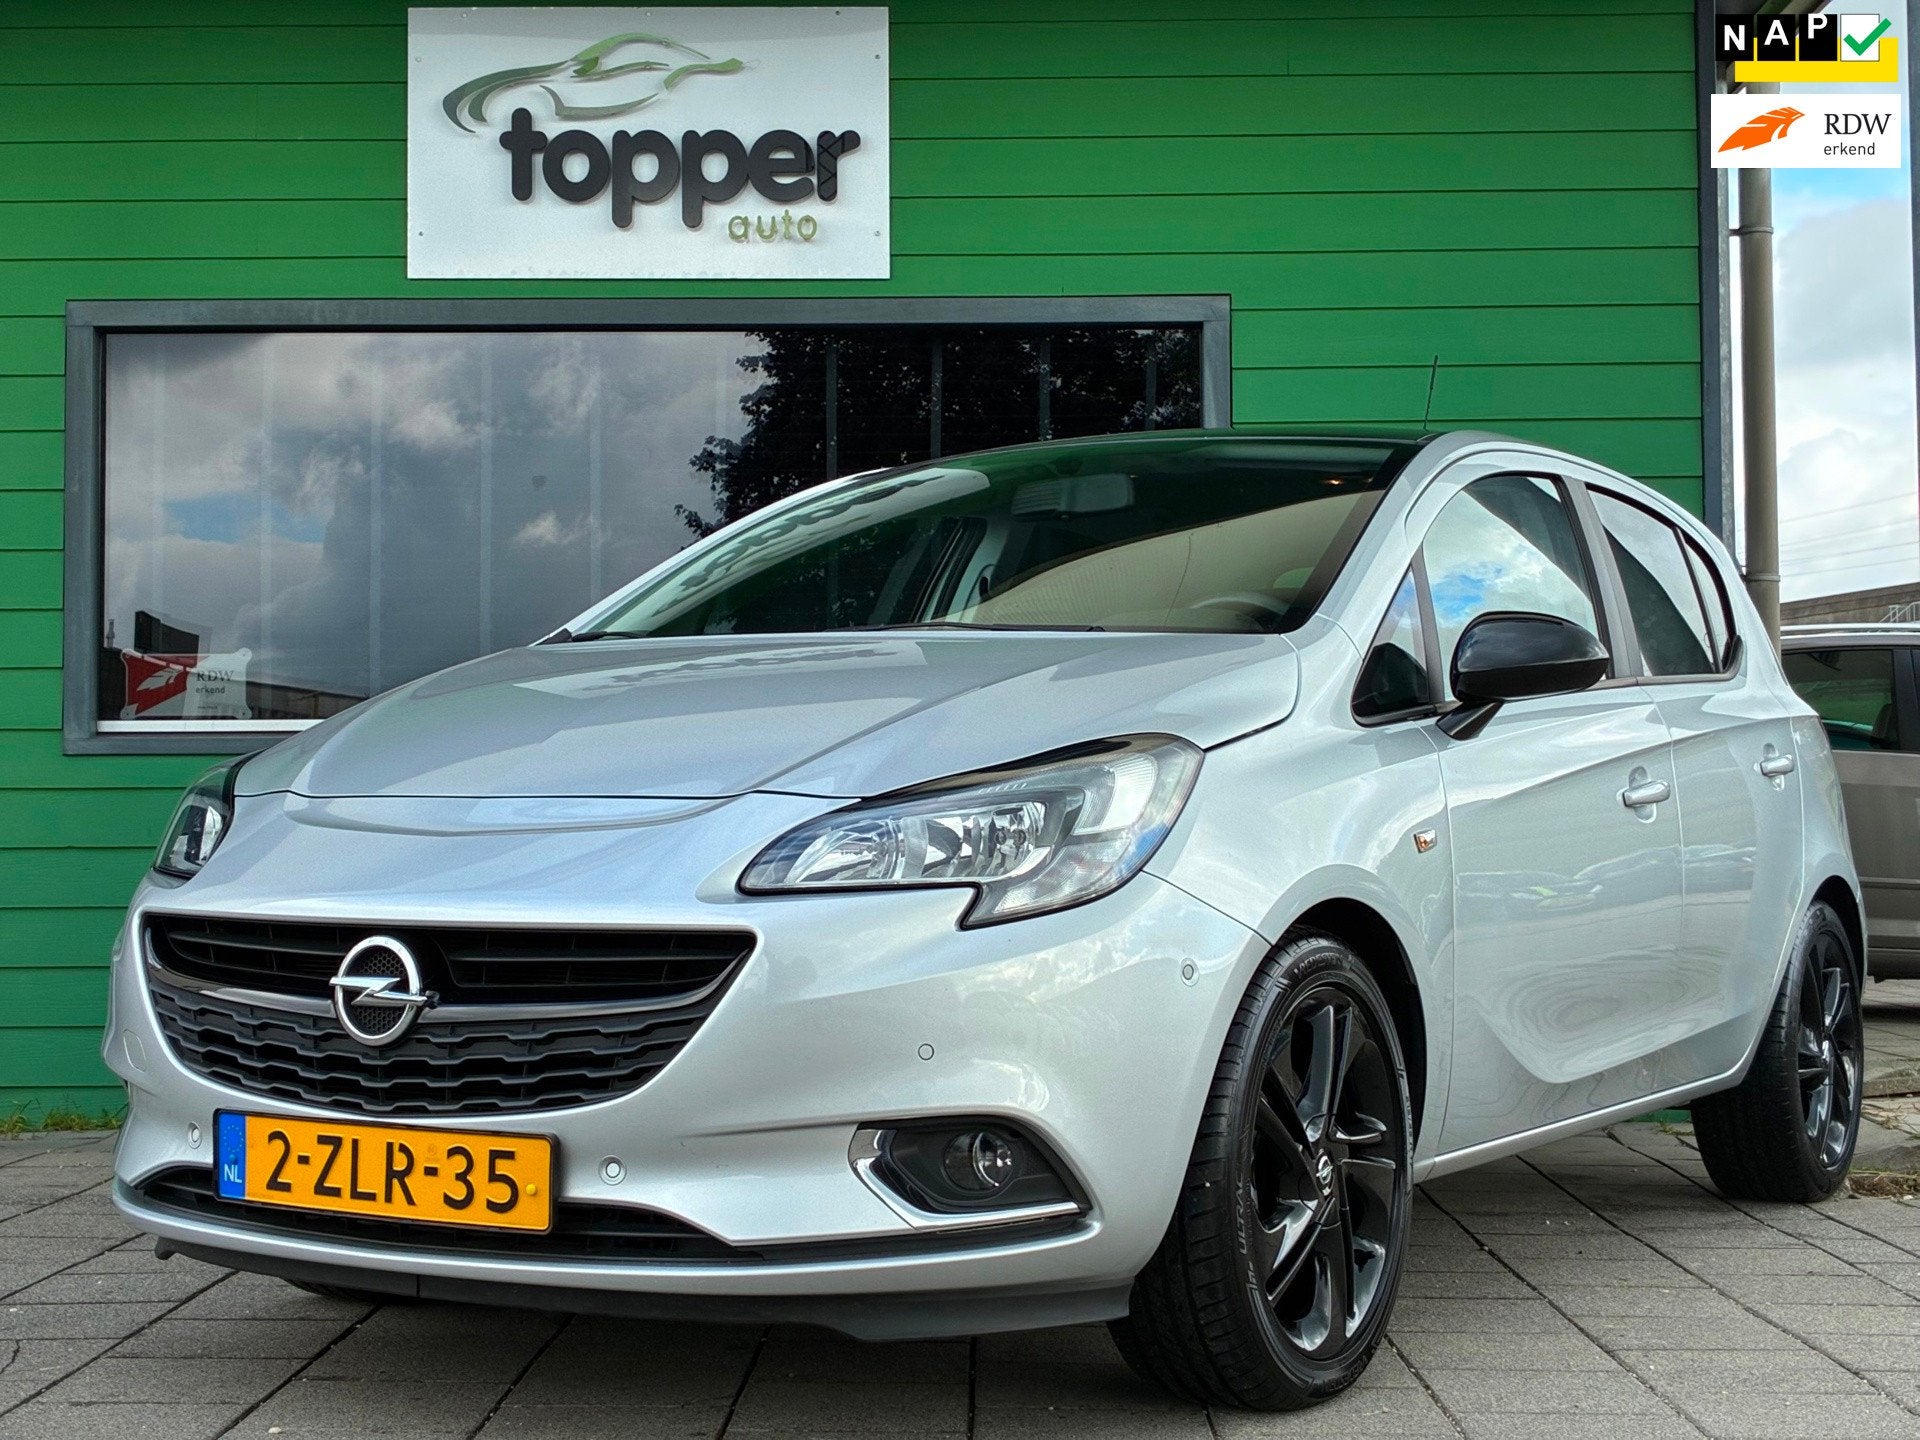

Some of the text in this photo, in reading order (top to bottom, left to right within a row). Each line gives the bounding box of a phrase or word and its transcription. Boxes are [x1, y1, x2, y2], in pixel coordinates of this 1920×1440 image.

[500, 107, 861, 228] topper
[728, 209, 818, 241] auto
[195, 686, 226, 694] erkend
[196, 669, 234, 682] RDW
[223, 1164, 243, 1184] NL
[266, 1130, 519, 1214] 2-ZLR-35
[1236, 1171, 1247, 1254] ULTRAC
